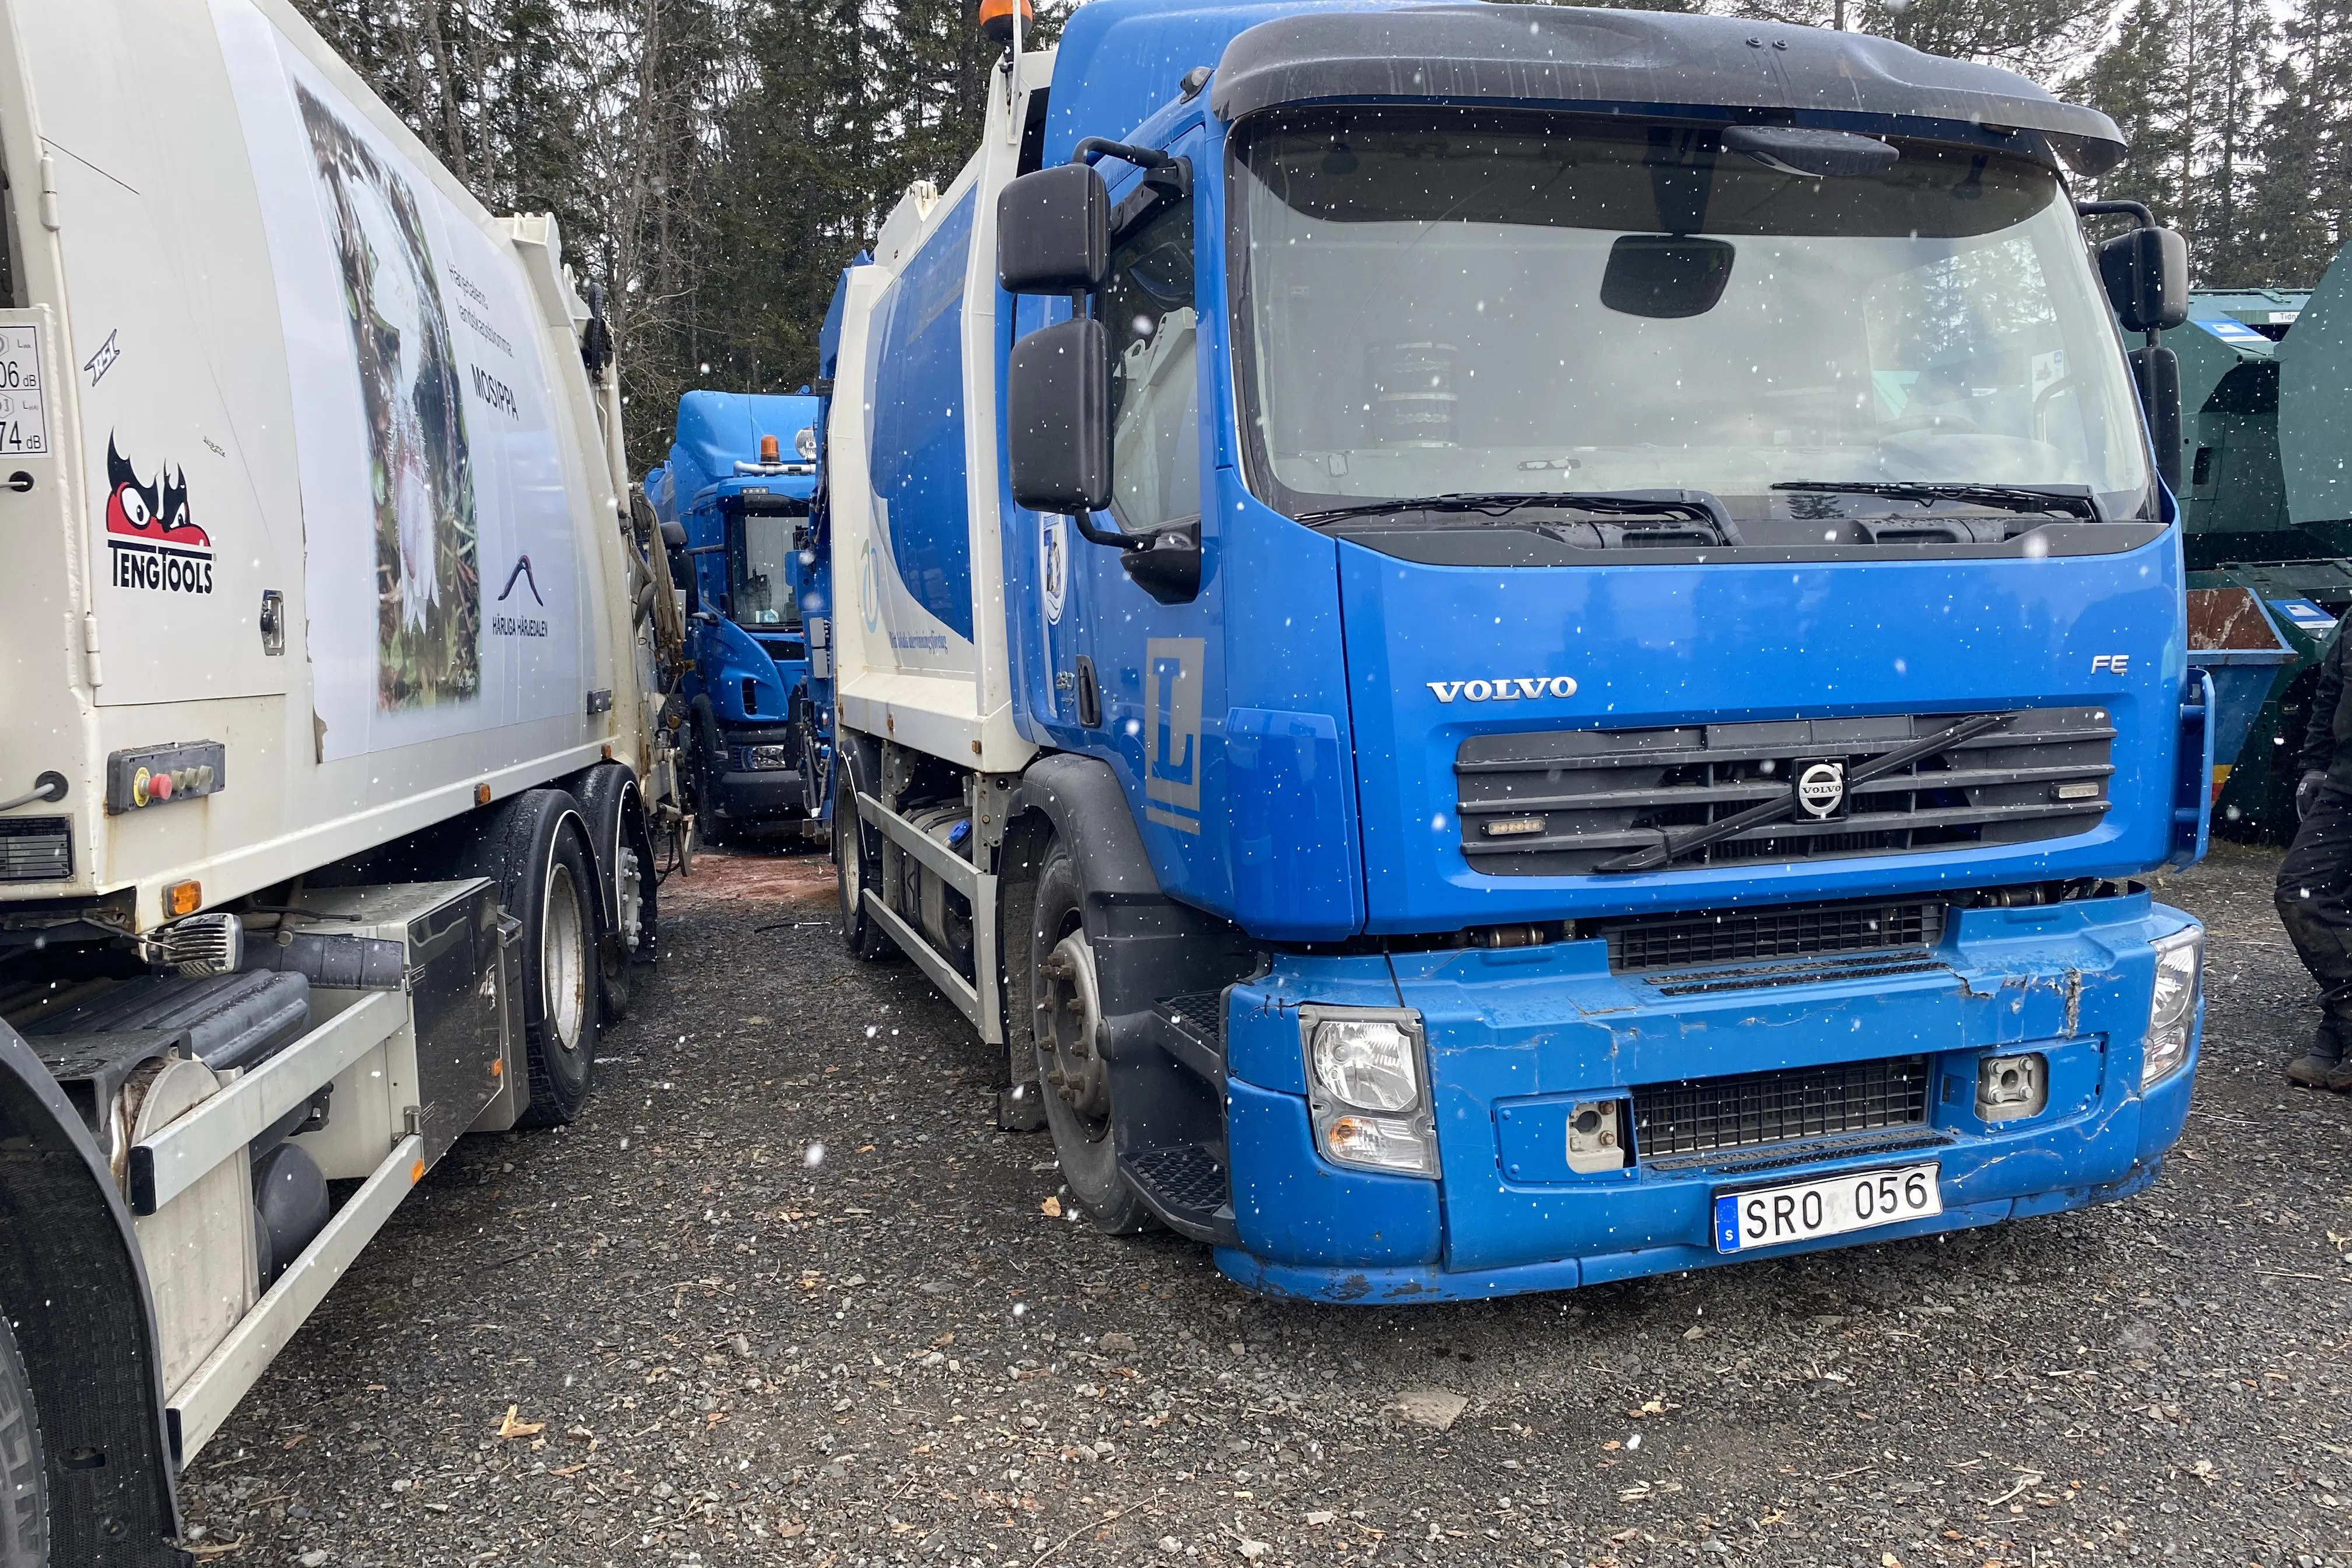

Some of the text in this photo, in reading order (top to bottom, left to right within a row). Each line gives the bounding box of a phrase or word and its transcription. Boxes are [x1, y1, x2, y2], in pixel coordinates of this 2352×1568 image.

[2280, 312, 2300, 320] Tidn
[23, 374, 36, 387] dB
[471, 363, 519, 421] MOSIPPA
[26, 435, 41, 449] dB
[492, 613, 548, 637] HÄRLIGA HÄRJEDALEN
[2091, 654, 2130, 674] FE
[1426, 676, 1577, 703] VOLVO
[1801, 785, 1842, 794] VOLVO
[1746, 1172, 1927, 1239] SRO 056
[1725, 1229, 1734, 1241] S
